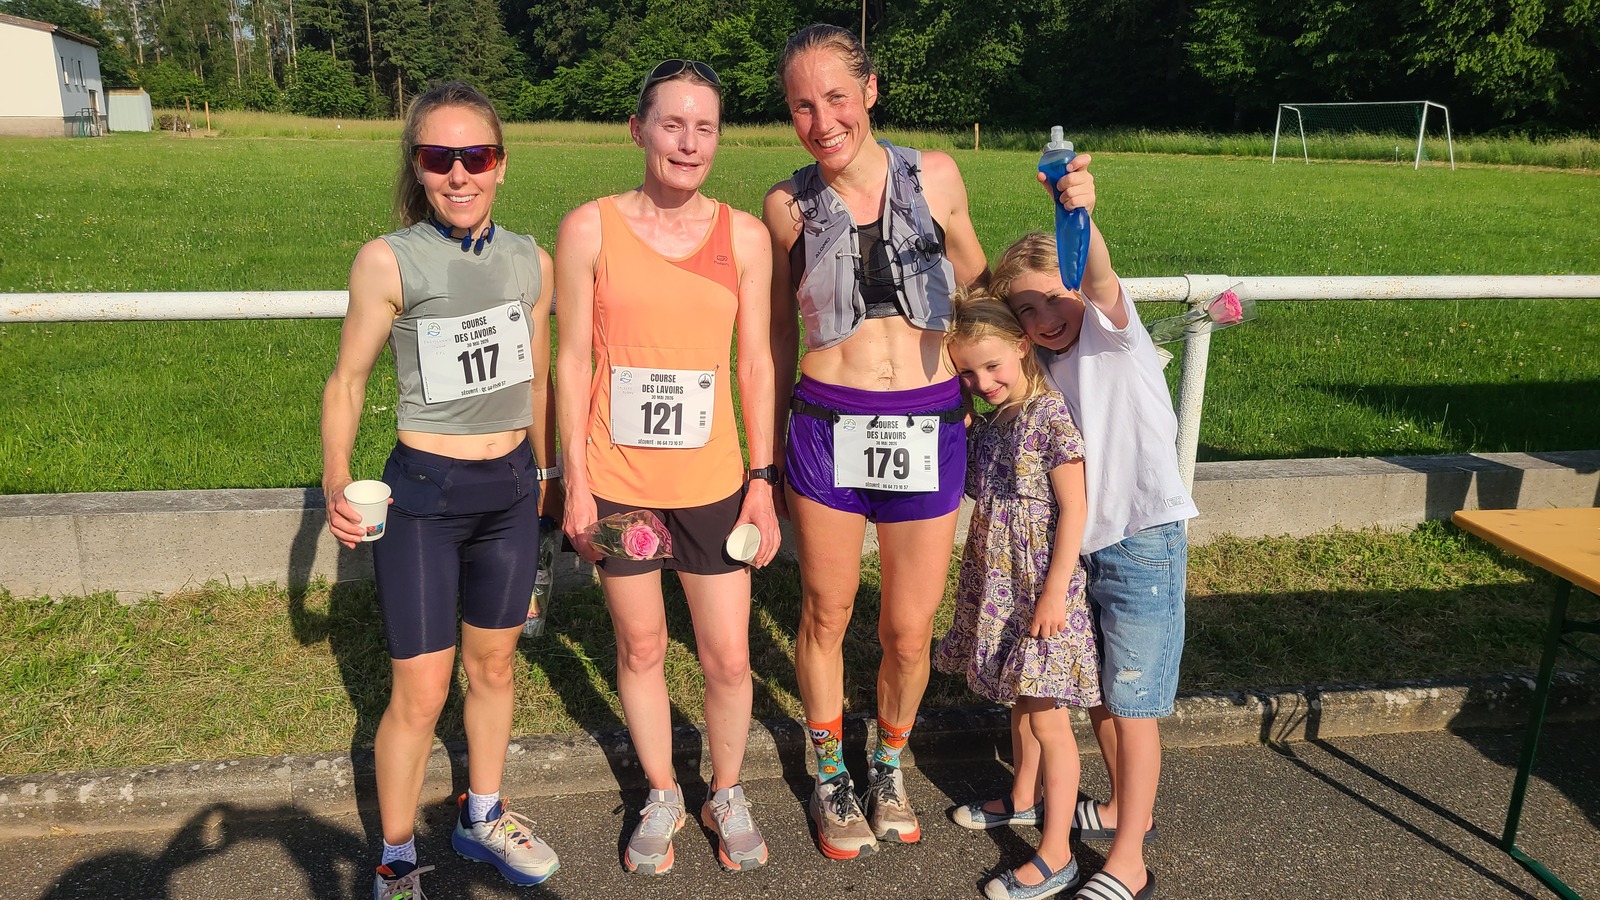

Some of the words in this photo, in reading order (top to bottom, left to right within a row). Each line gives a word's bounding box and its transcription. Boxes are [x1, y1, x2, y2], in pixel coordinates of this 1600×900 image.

[462, 316, 487, 330] COURSE
[454, 333, 468, 343] DES
[470, 326, 496, 340] LAVOIRS
[458, 343, 500, 384] 117
[650, 374, 676, 382] COURSE
[642, 384, 654, 393] DES
[656, 386, 684, 394] LAVOIRS
[641, 402, 682, 435] 121
[864, 447, 910, 479] 179
